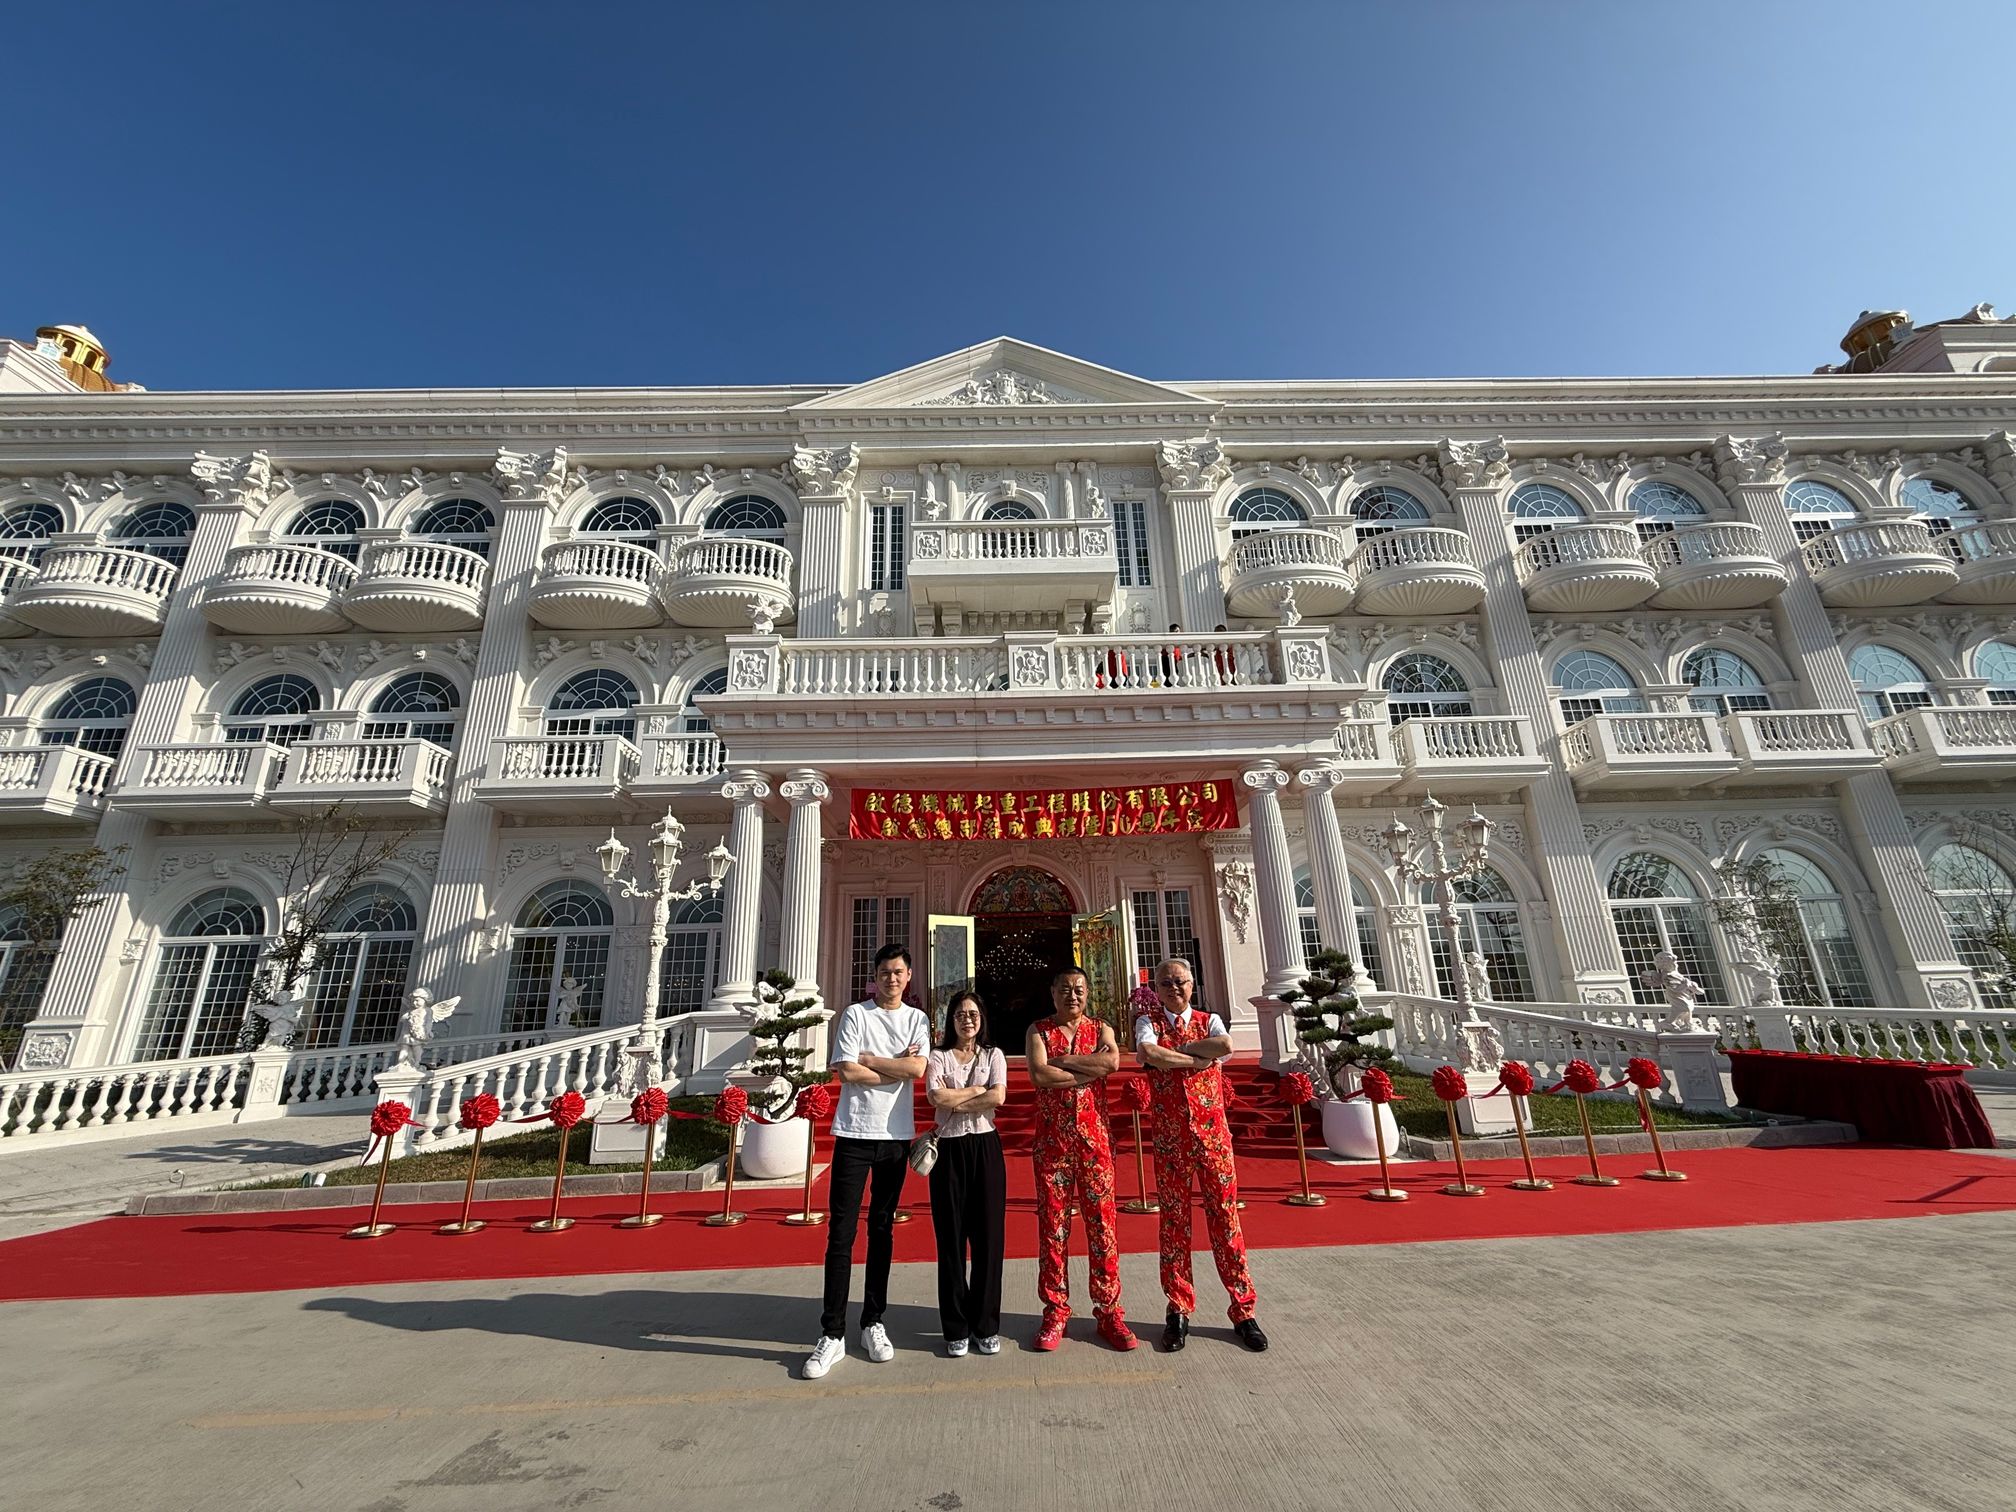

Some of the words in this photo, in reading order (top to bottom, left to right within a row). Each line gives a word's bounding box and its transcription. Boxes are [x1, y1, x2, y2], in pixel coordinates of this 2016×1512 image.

[864, 783, 1218, 815] 啟德機械起重工程股份有限公司
